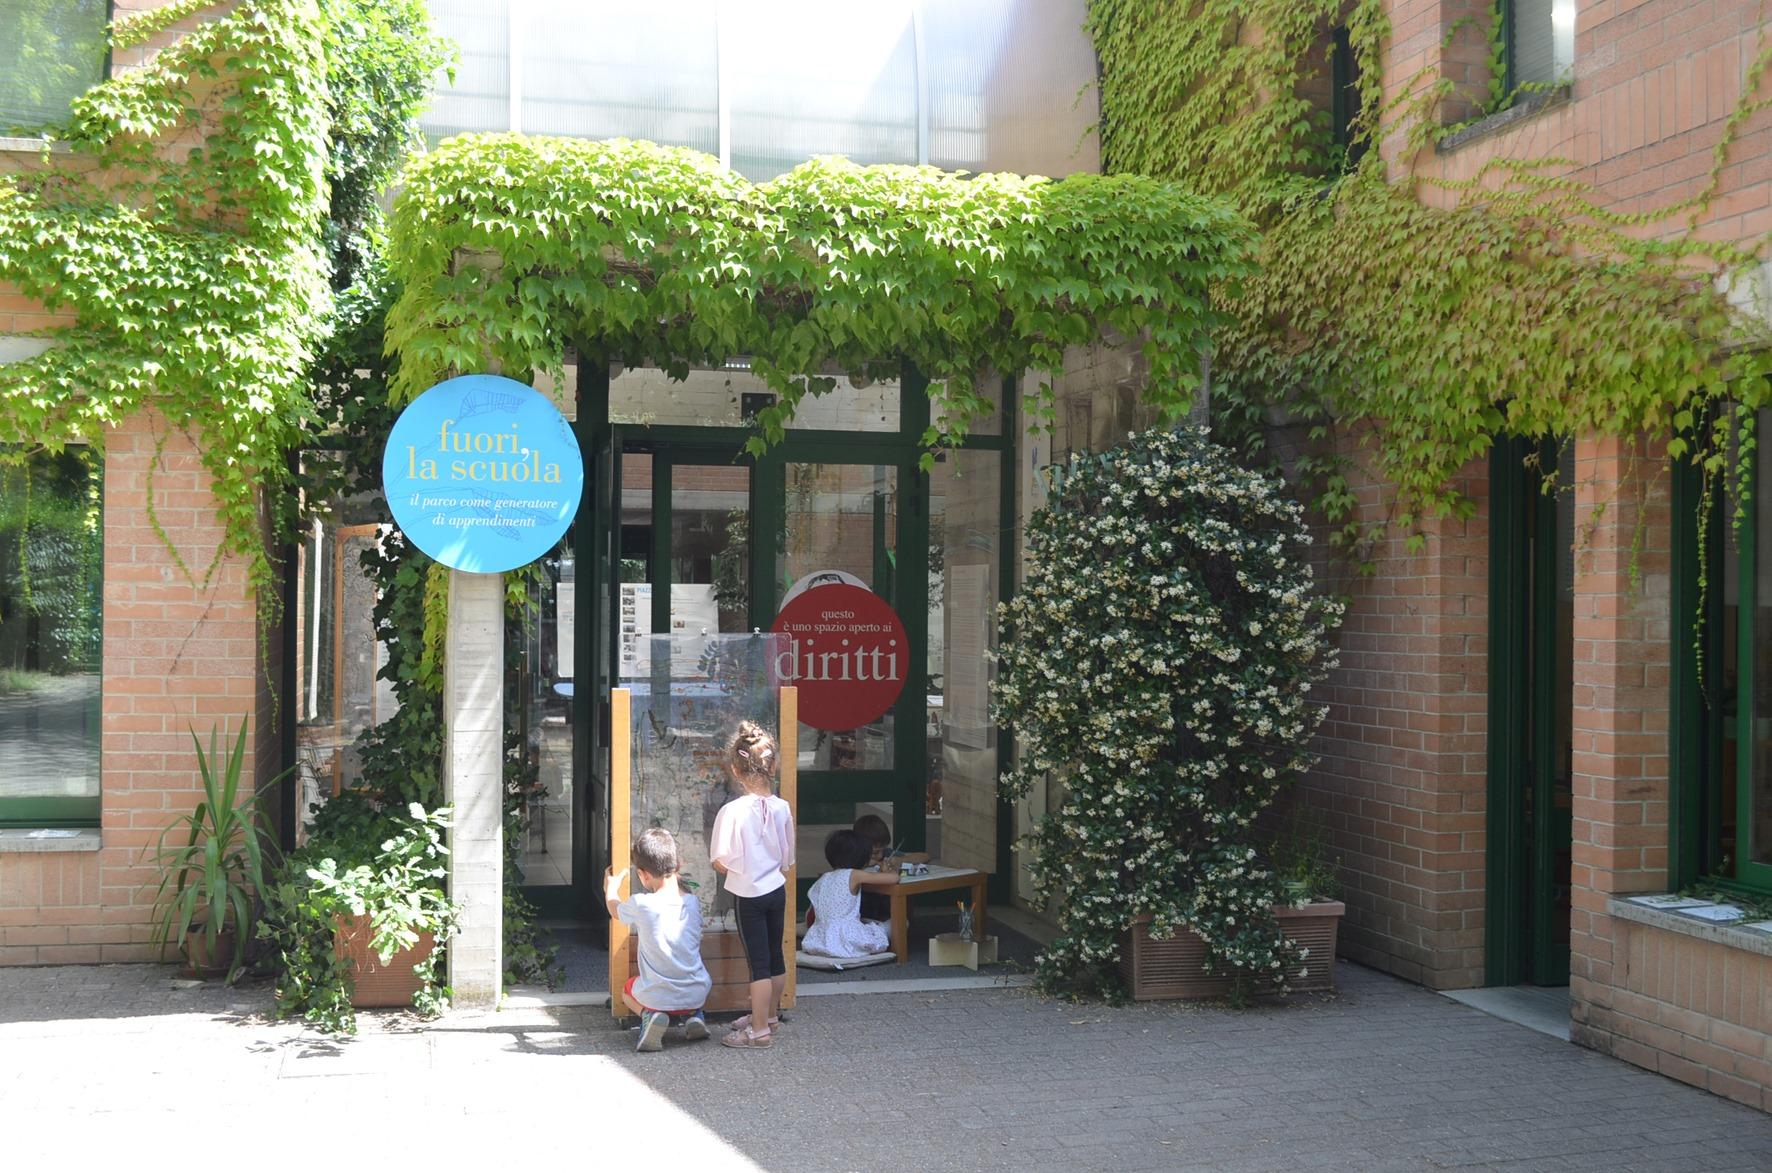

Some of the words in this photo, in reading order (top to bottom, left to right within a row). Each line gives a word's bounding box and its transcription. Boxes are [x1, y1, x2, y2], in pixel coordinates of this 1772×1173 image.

[406, 445, 439, 480] la
[451, 450, 562, 483] scuola
[410, 493, 419, 506] il
[422, 497, 457, 510] parco
[459, 498, 491, 509] come
[494, 498, 558, 511] generatore
[432, 513, 445, 526] di
[449, 514, 536, 529] apprendimenti
[821, 610, 855, 619] questo
[783, 621, 790, 631] è
[792, 624, 812, 632] uno
[814, 621, 846, 634] spazio
[849, 623, 880, 634] aperto
[883, 622, 892, 632] ai
[774, 639, 900, 681] diritti
